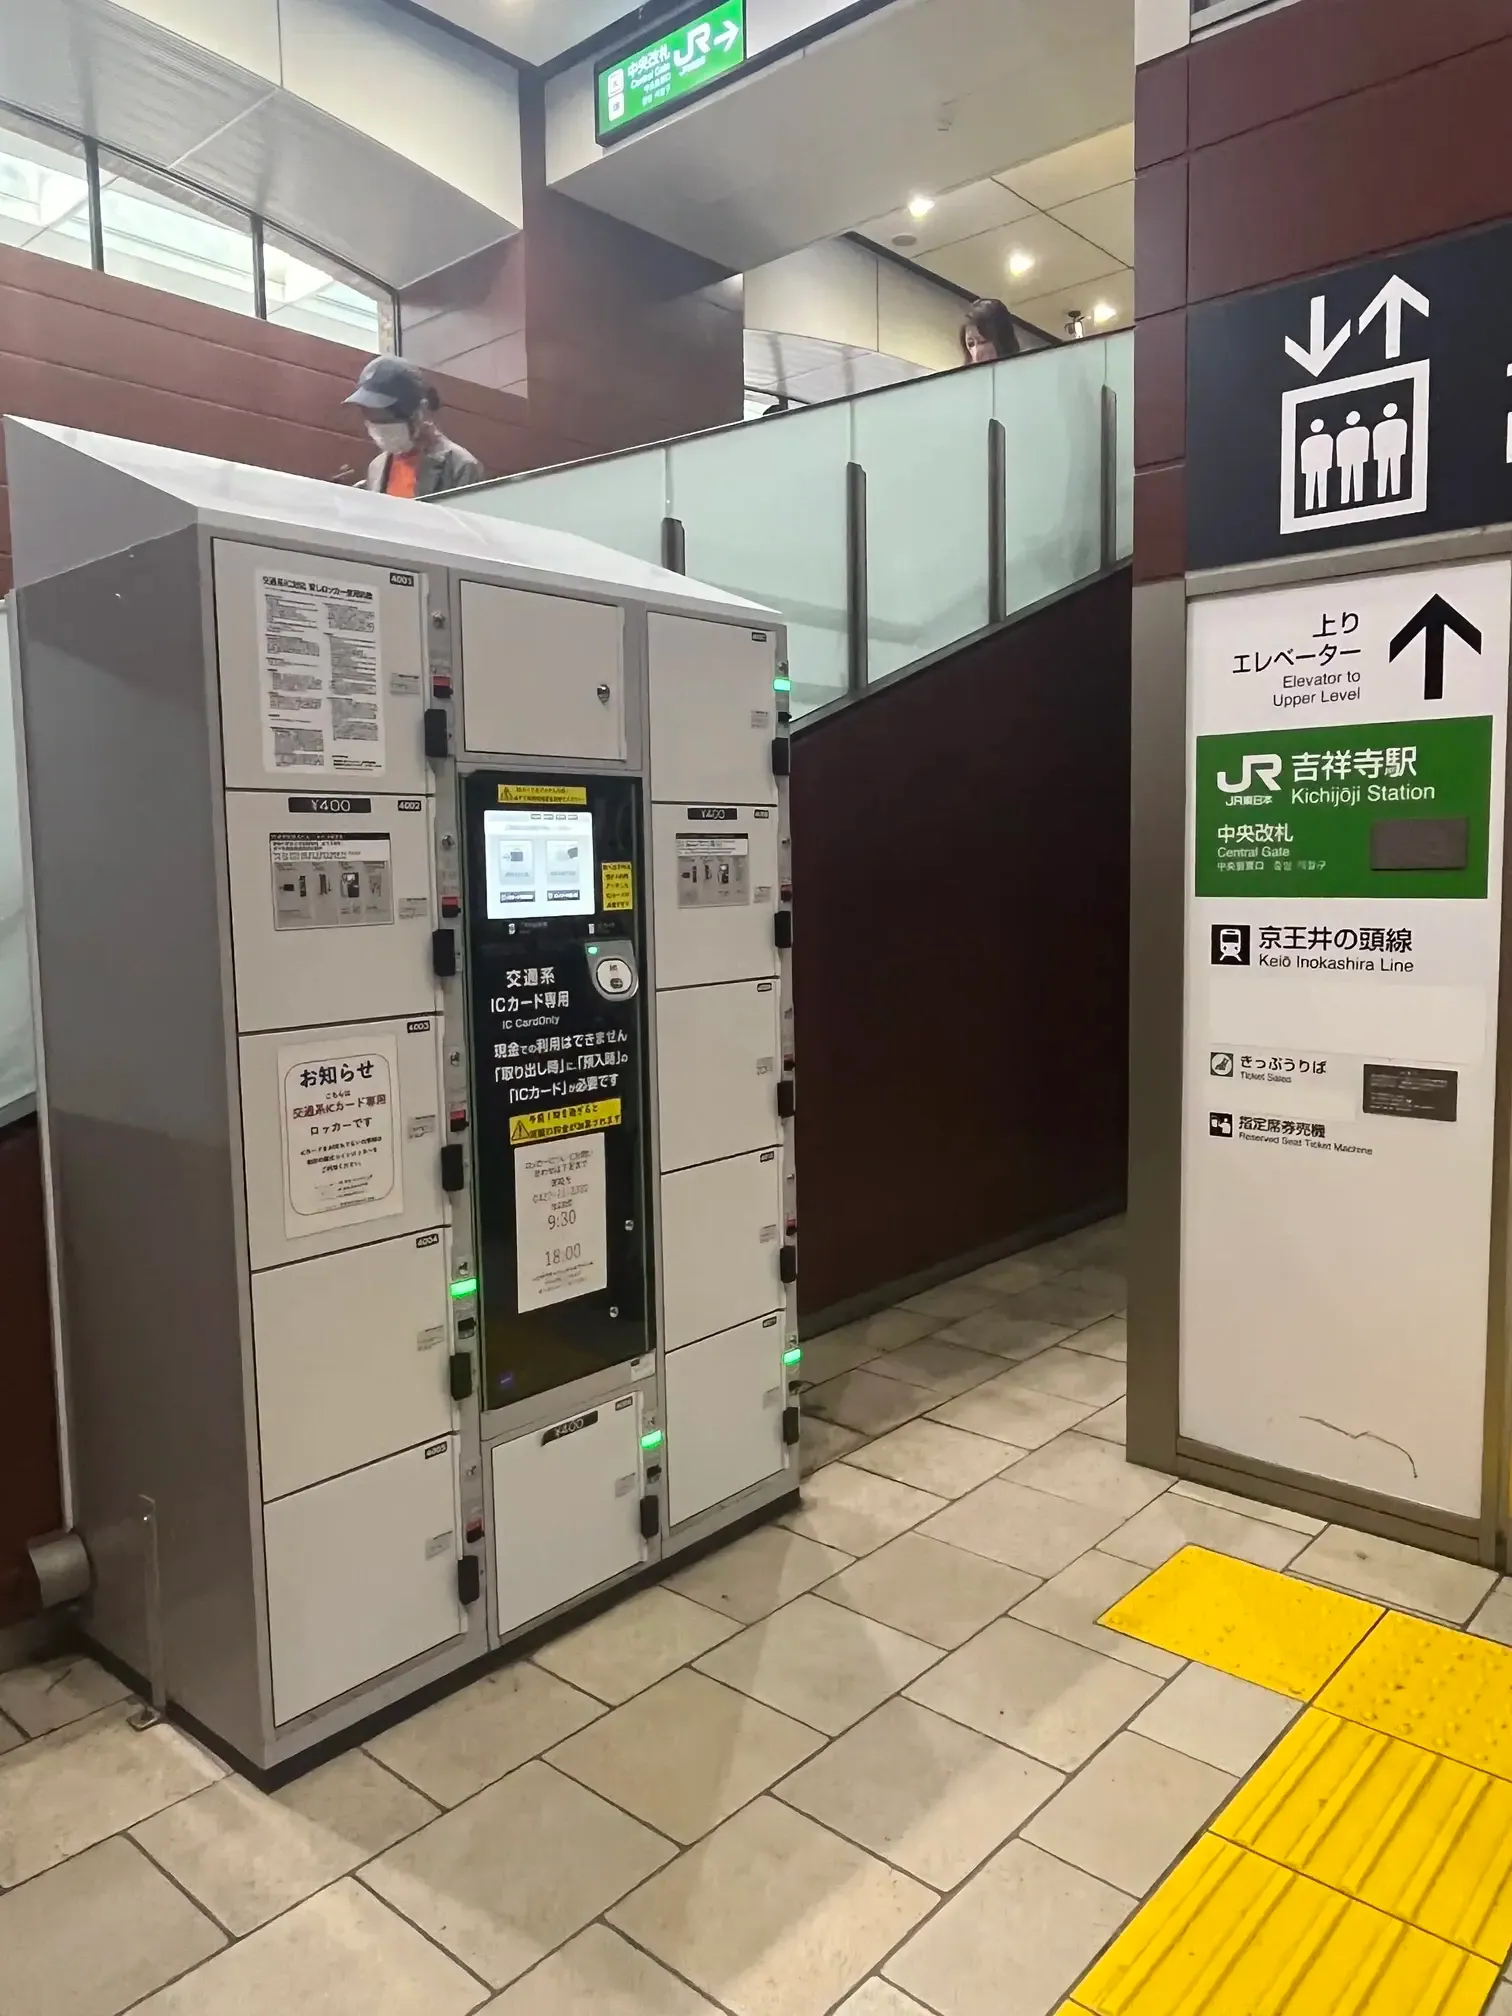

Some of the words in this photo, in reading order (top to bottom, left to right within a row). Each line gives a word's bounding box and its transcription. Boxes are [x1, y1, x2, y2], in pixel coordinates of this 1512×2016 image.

[674, 22, 711, 67] JR
[1312, 612, 1359, 638] 上り
[1232, 643, 1361, 674] エレベーター
[1283, 672, 1342, 689] Elevator
[1347, 671, 1361, 683] to
[1273, 692, 1315, 708] Upper
[1321, 687, 1361, 704] Level
[1217, 754, 1282, 793] JR
[1291, 746, 1417, 783] 吉祥寺駅
[1367, 784, 1435, 802] Station
[399, 801, 421, 811] 4002
[1218, 823, 1294, 844] 中央改札
[1217, 846, 1259, 858] Central
[1261, 846, 1290, 858] Gate
[1258, 925, 1413, 953] 京王井の頭線
[1296, 956, 1375, 972] Inokashira
[1380, 958, 1414, 973] Line
[506, 967, 556, 988] 交通系
[491, 990, 569, 1013] ICカード専用
[408, 1021, 430, 1032] 4003
[502, 1019, 513, 1030] IC
[494, 1029, 628, 1059] 現金での利用はできません
[300, 1060, 374, 1088] お知らせ
[1241, 1055, 1327, 1074] きっぷうりば
[311, 1117, 372, 1135] ロッカーです
[1239, 1115, 1325, 1139] 指定席券売機
[548, 1209, 576, 1230] 9:30
